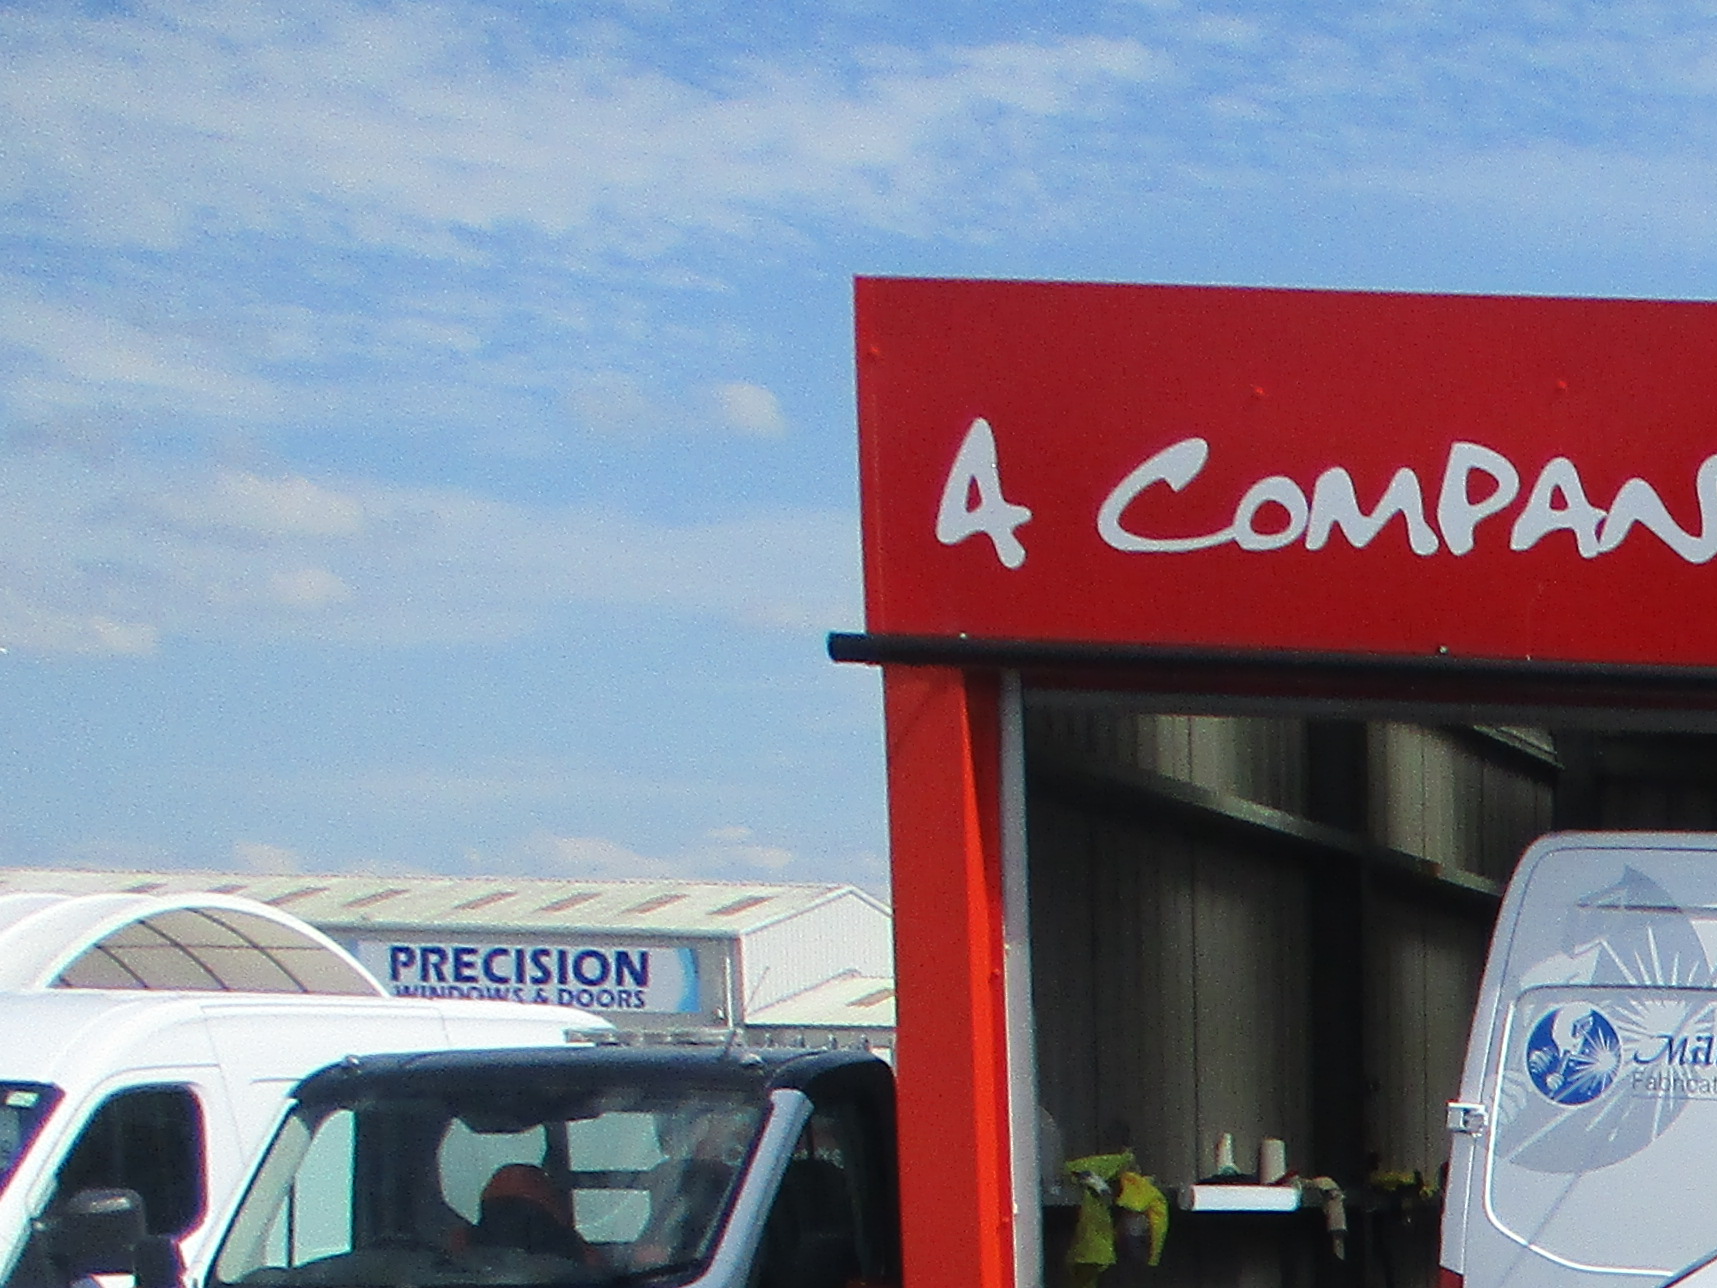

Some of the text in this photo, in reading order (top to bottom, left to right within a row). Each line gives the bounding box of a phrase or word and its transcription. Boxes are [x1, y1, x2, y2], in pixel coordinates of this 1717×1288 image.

[936, 418, 1031, 568] A
[389, 946, 649, 987] PRECISION
[394, 985, 645, 1008] WINDOWS & DOORS
